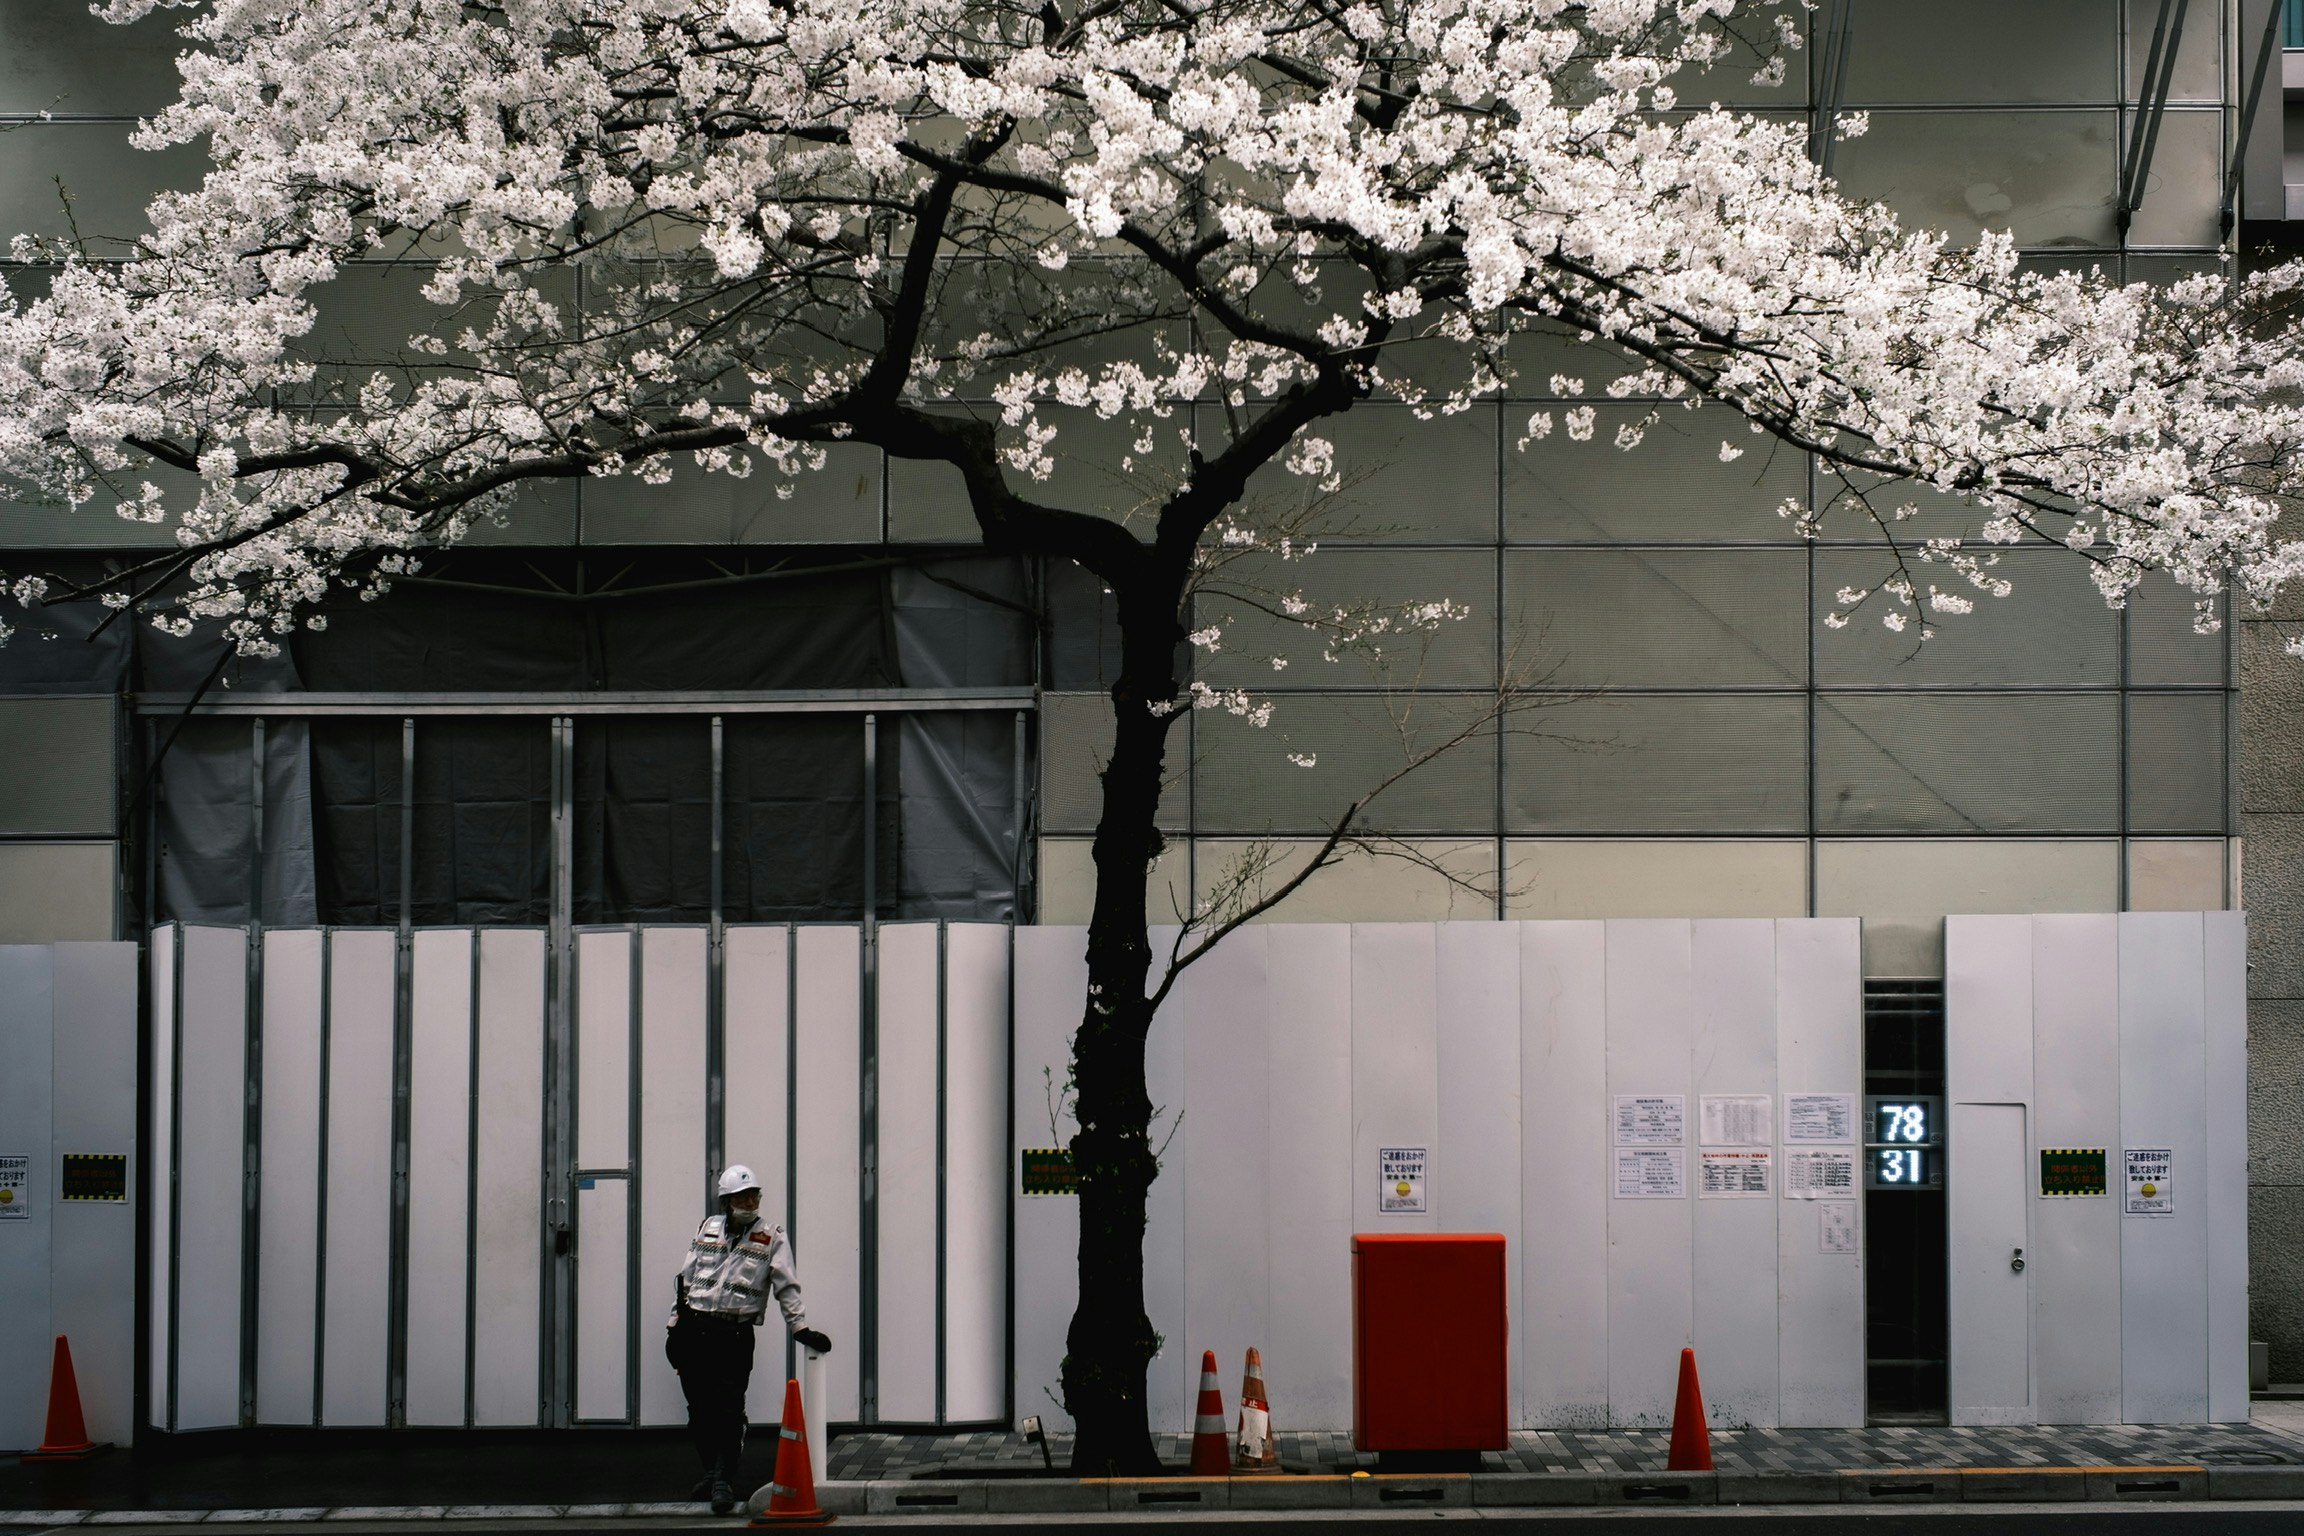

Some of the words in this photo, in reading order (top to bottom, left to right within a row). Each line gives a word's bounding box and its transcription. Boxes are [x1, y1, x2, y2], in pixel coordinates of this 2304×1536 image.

[1881, 1105, 1925, 1142] 78
[1383, 1152, 1424, 1161] ご迷惑をおかけ
[2127, 1152, 2169, 1161] ご迷惑をおかけ
[1384, 1164, 1423, 1173] 致しております
[1882, 1150, 1921, 1182] 31
[2051, 1164, 2096, 1173] 関係者以外
[2128, 1165, 2168, 1174] 致しております
